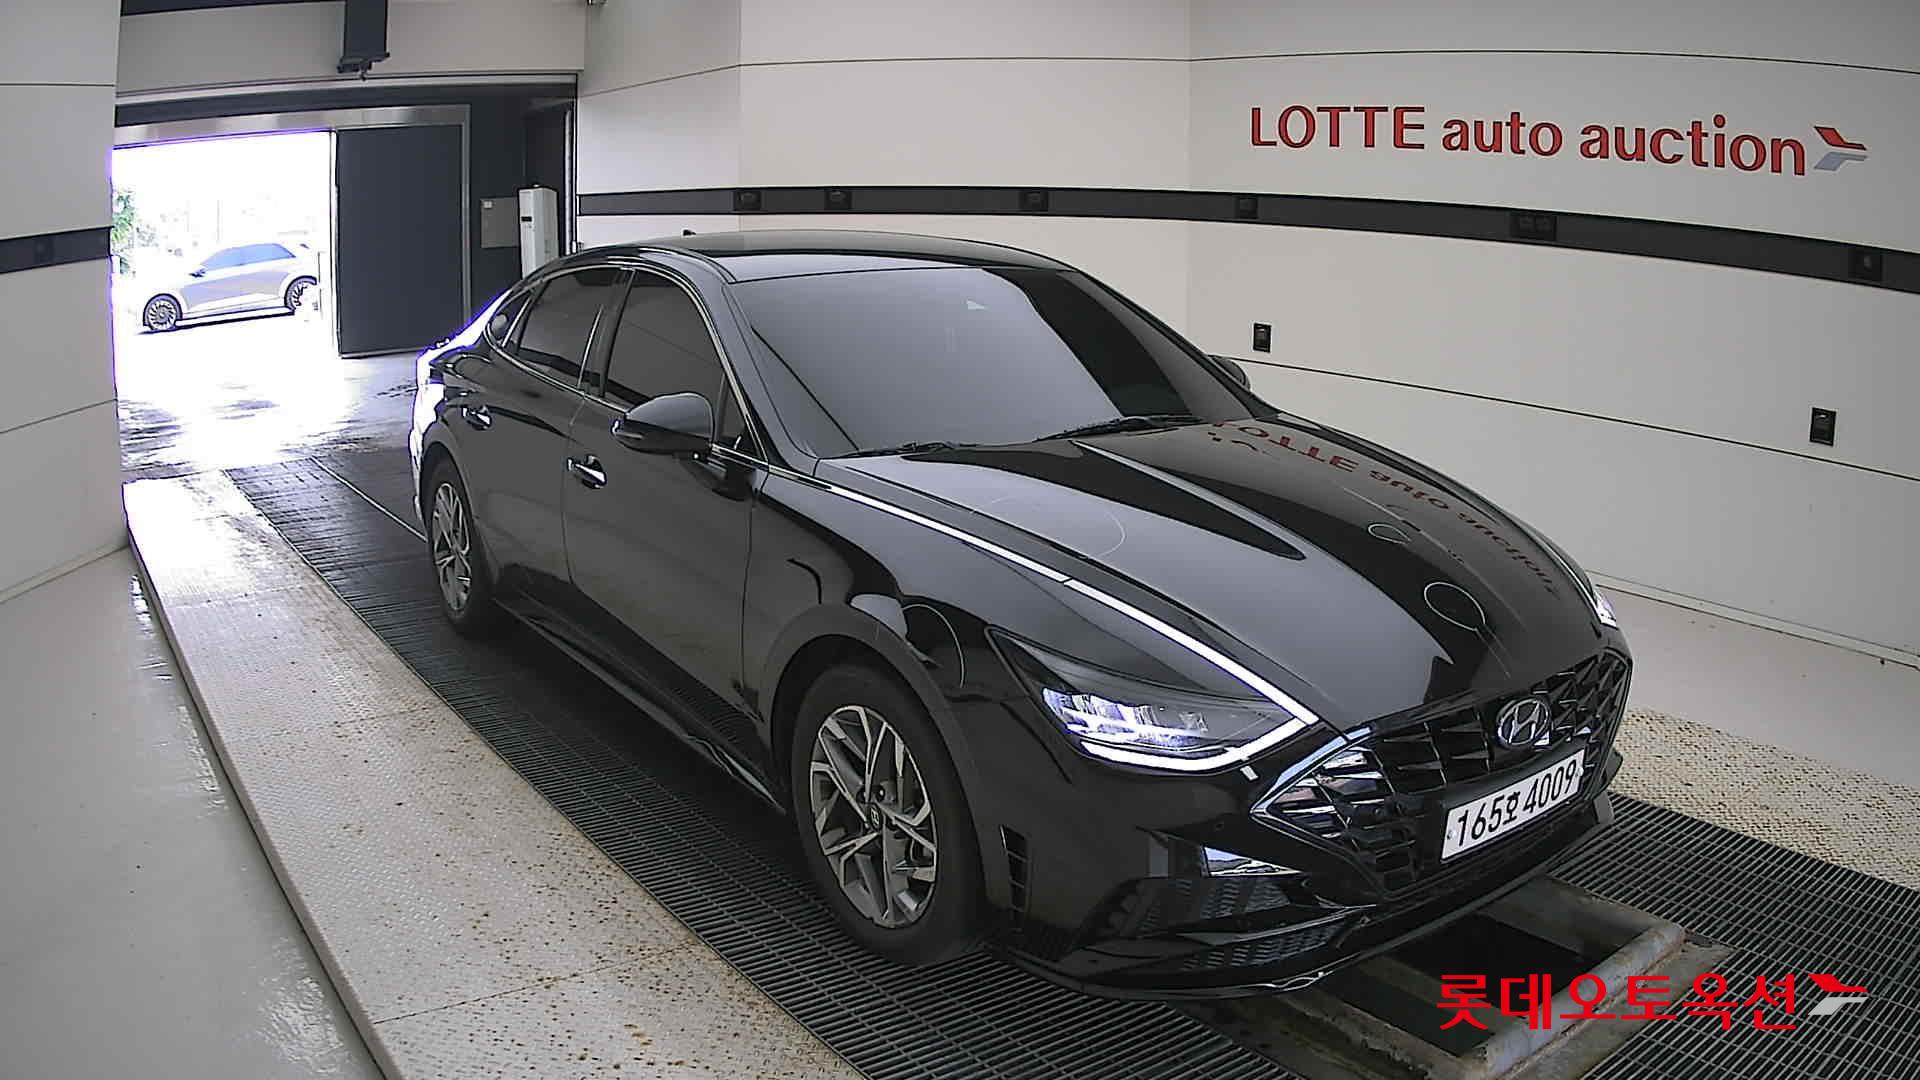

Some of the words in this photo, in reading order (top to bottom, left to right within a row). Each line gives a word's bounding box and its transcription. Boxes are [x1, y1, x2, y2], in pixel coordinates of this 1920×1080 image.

[1251, 106, 1425, 149] LOTTE
[1443, 111, 1564, 156] auto
[1579, 114, 1807, 176] auction
[1458, 792, 1520, 846] 165호
[1523, 759, 1577, 813] 4009
